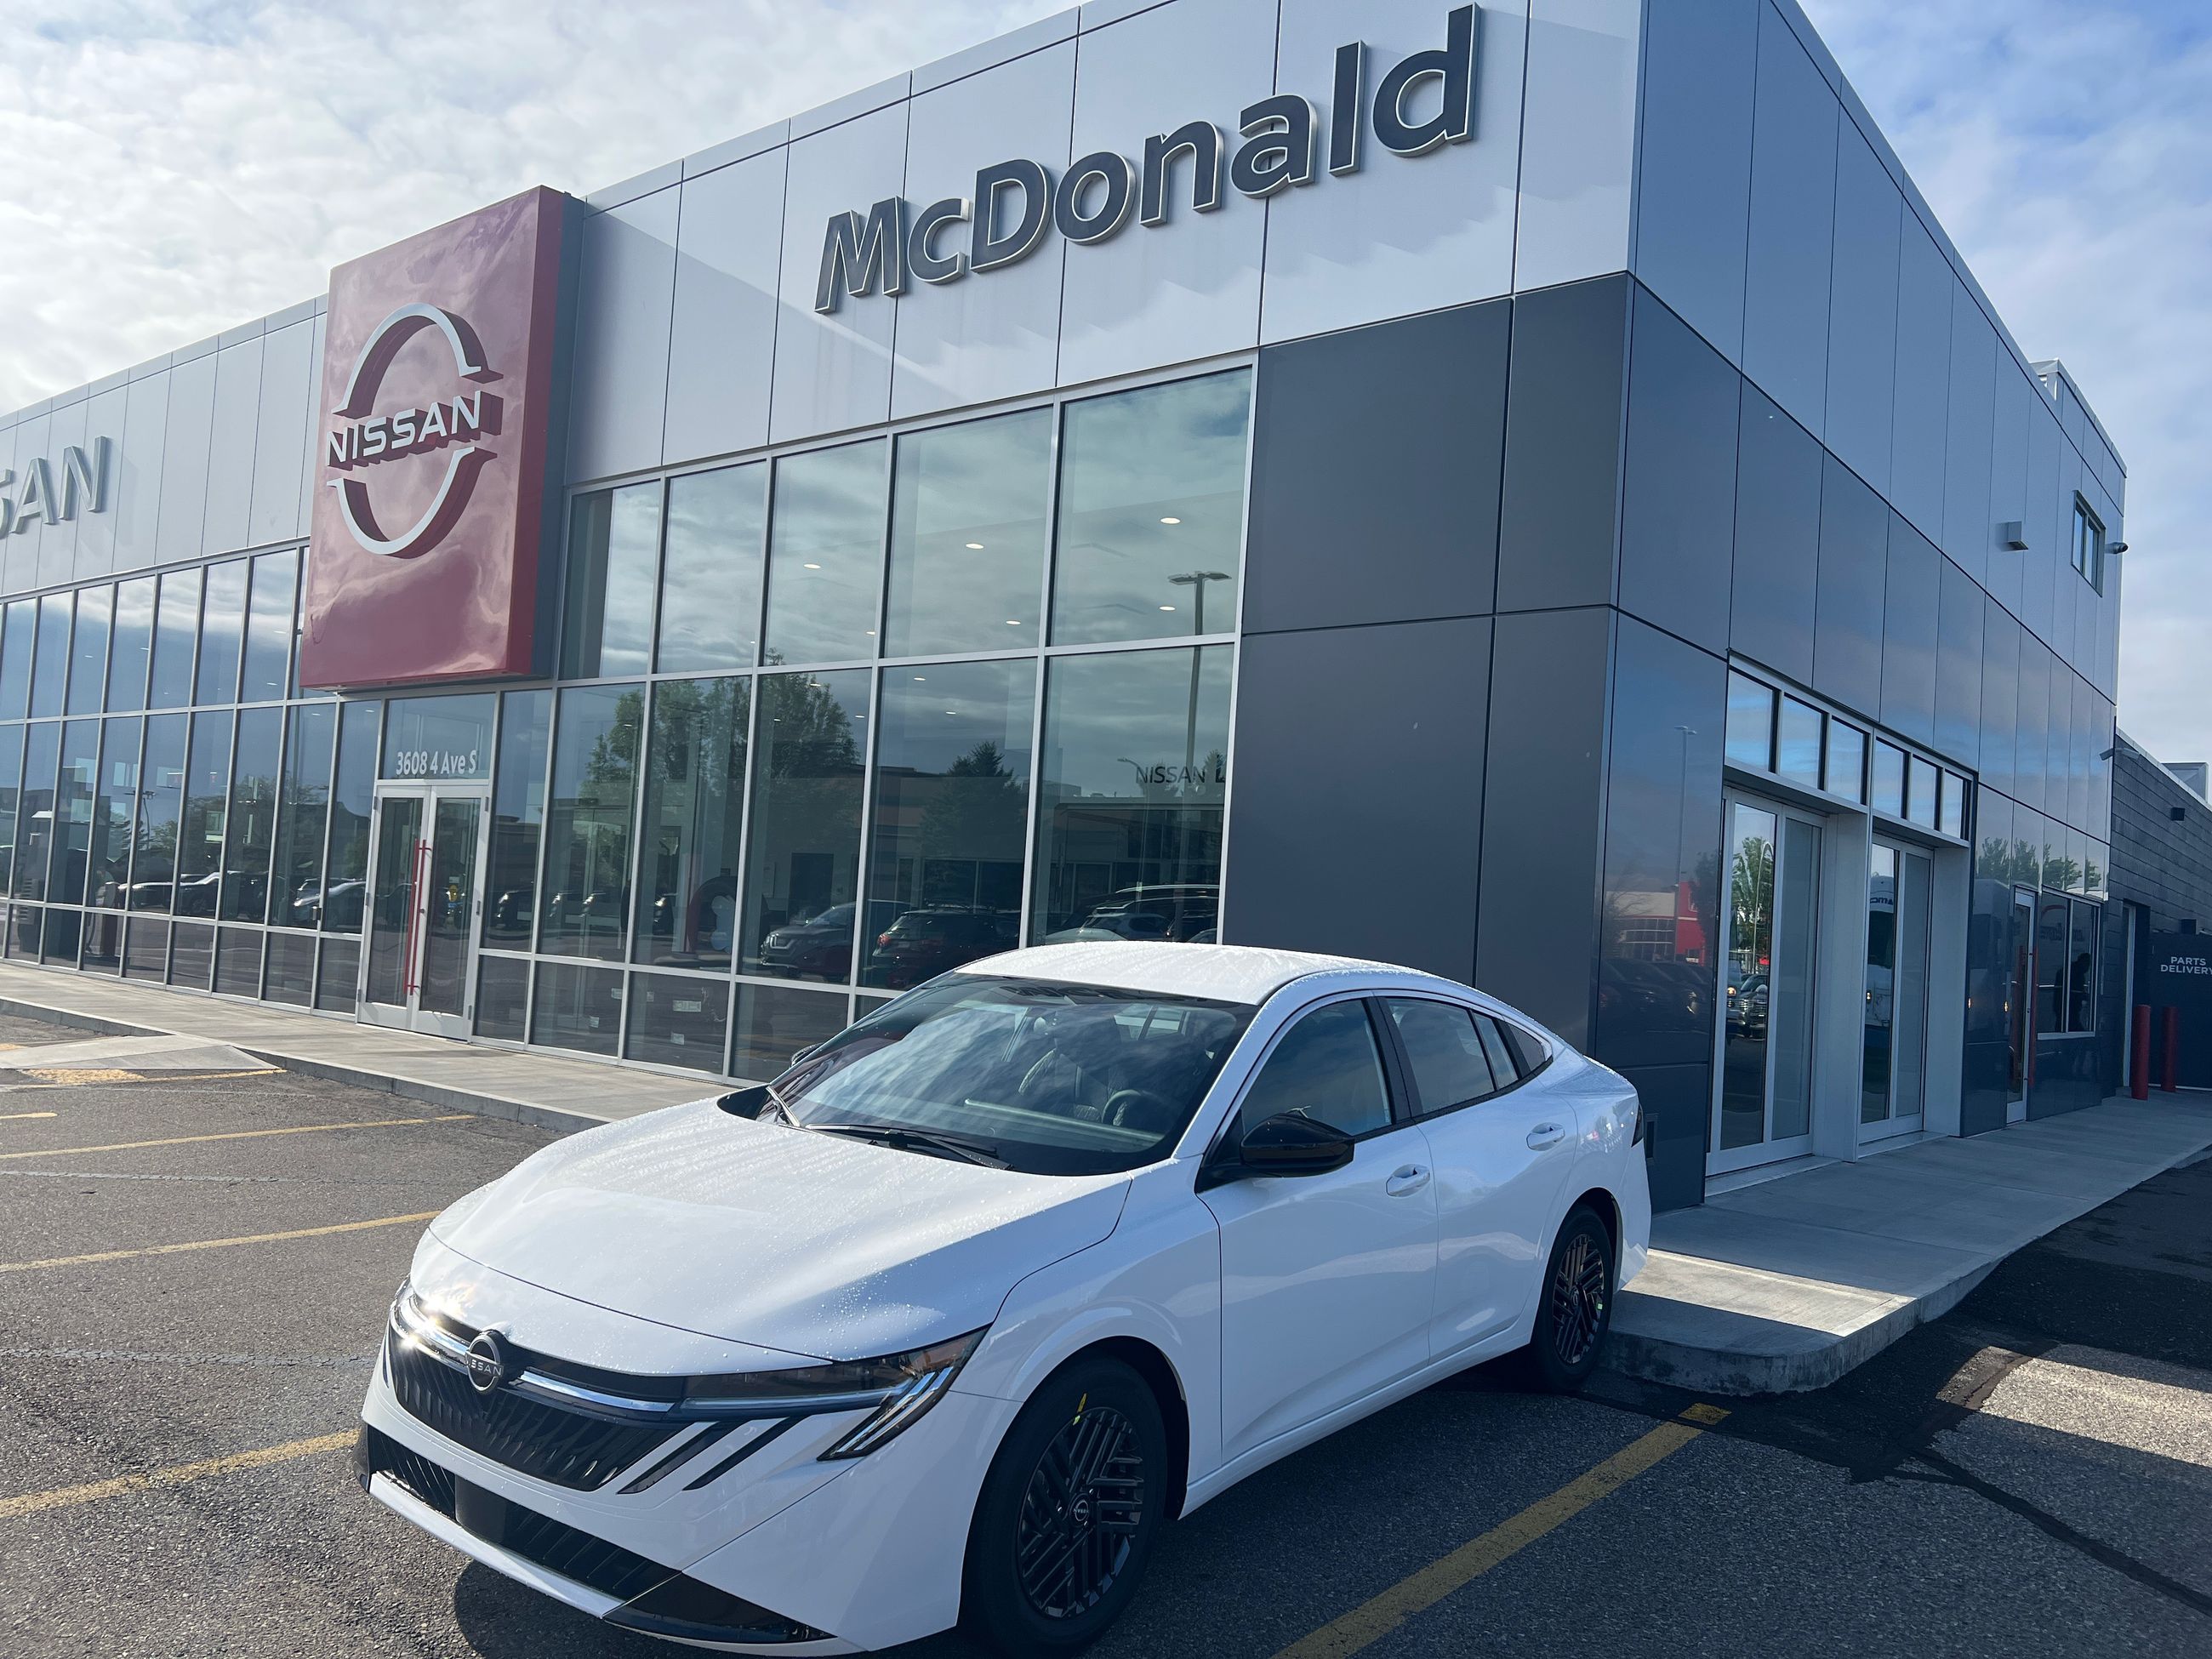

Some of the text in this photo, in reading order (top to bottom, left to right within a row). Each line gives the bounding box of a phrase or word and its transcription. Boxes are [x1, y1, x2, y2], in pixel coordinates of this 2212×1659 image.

[814, 2, 1480, 315] McDonald
[326, 391, 482, 467] NISSAN
[396, 749, 476, 775] 3608 4 Ave S
[1136, 766, 1206, 784] NISSAN
[2170, 956, 2207, 966] PARTS
